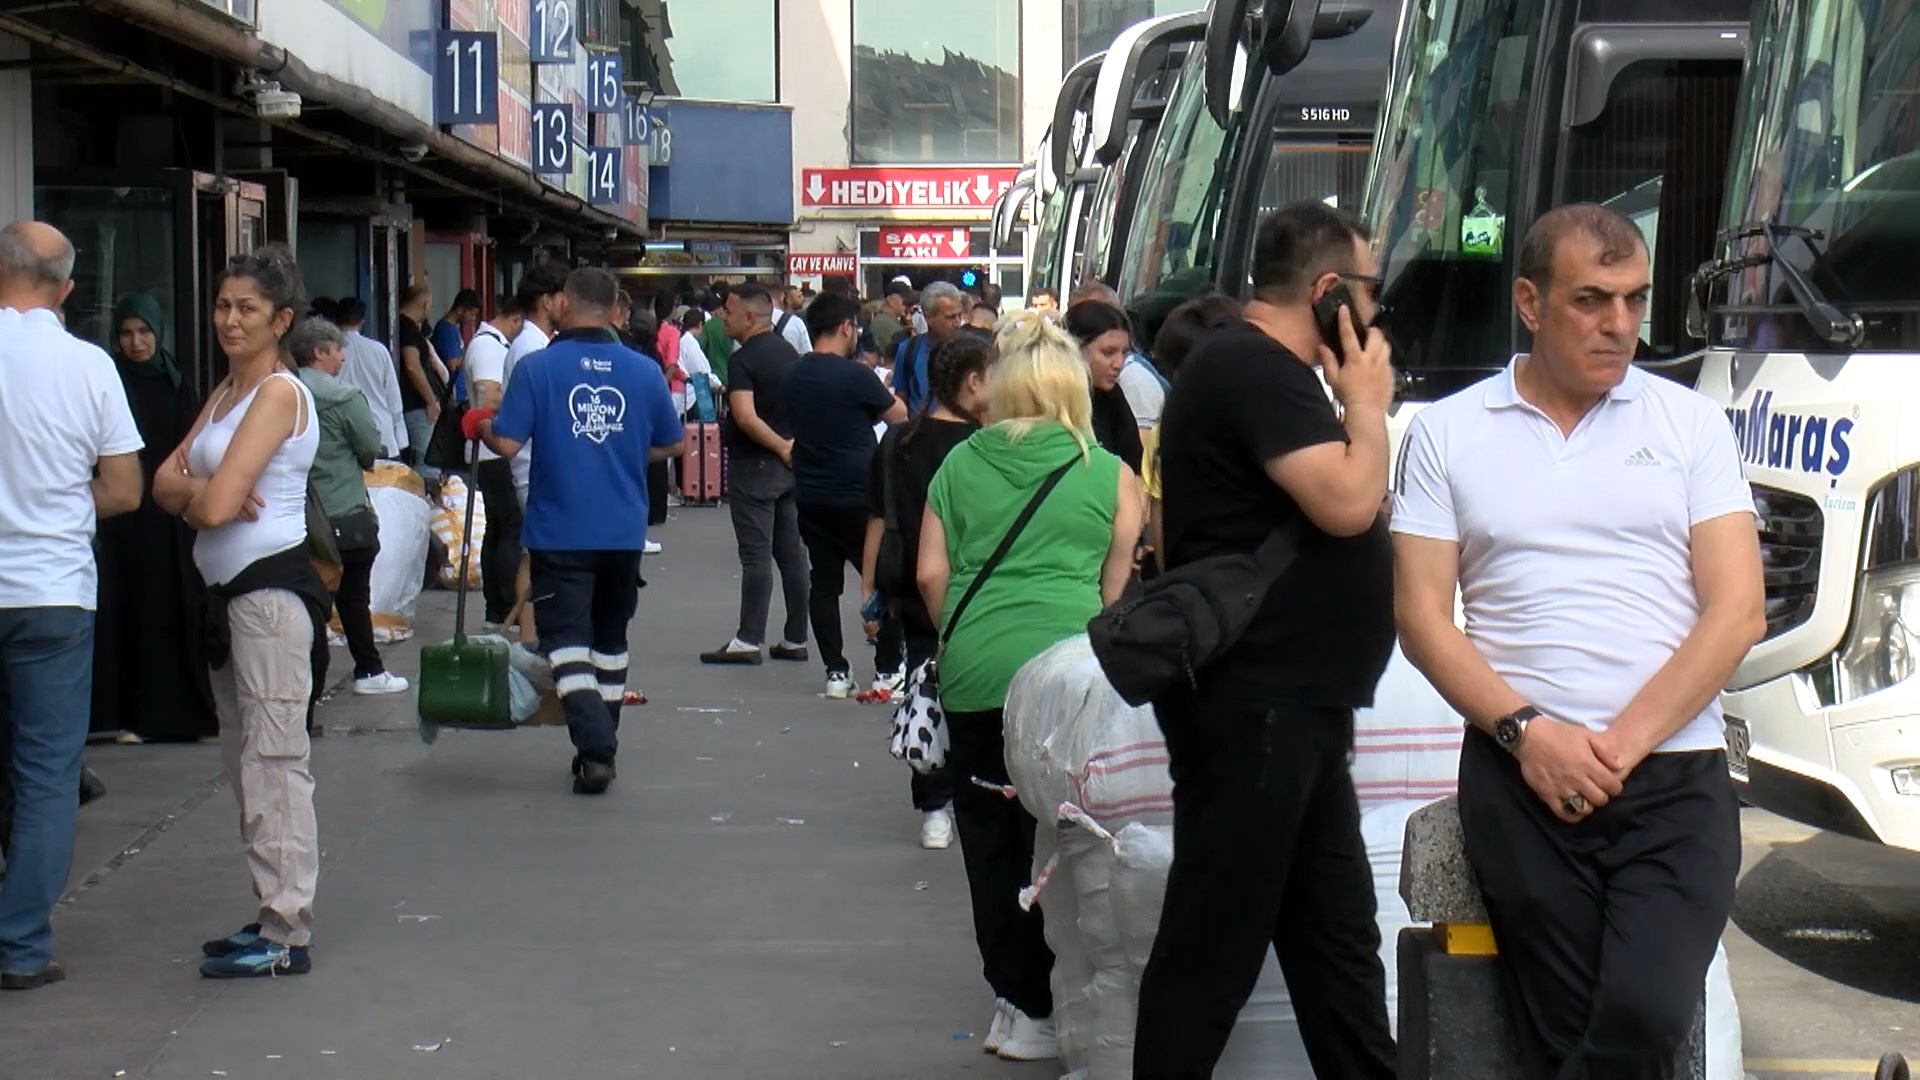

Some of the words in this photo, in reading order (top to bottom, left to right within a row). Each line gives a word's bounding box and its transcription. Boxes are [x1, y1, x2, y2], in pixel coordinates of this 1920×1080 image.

[535, 0, 569, 58] 12
[446, 39, 482, 114] 11
[590, 61, 618, 108] 15
[626, 101, 648, 141] 16
[1301, 107, 1309, 120] S
[1310, 108, 1331, 120] 516
[1332, 109, 1350, 120] HD
[533, 109, 567, 168] 13
[652, 129, 671, 162] 18
[588, 151, 615, 198] 14
[886, 233, 945, 244] SAAT
[891, 247, 938, 257] TAKI
[810, 257, 822, 271] VE
[823, 257, 855, 271] KAHVE
[1823, 495, 1857, 510] Turizm
